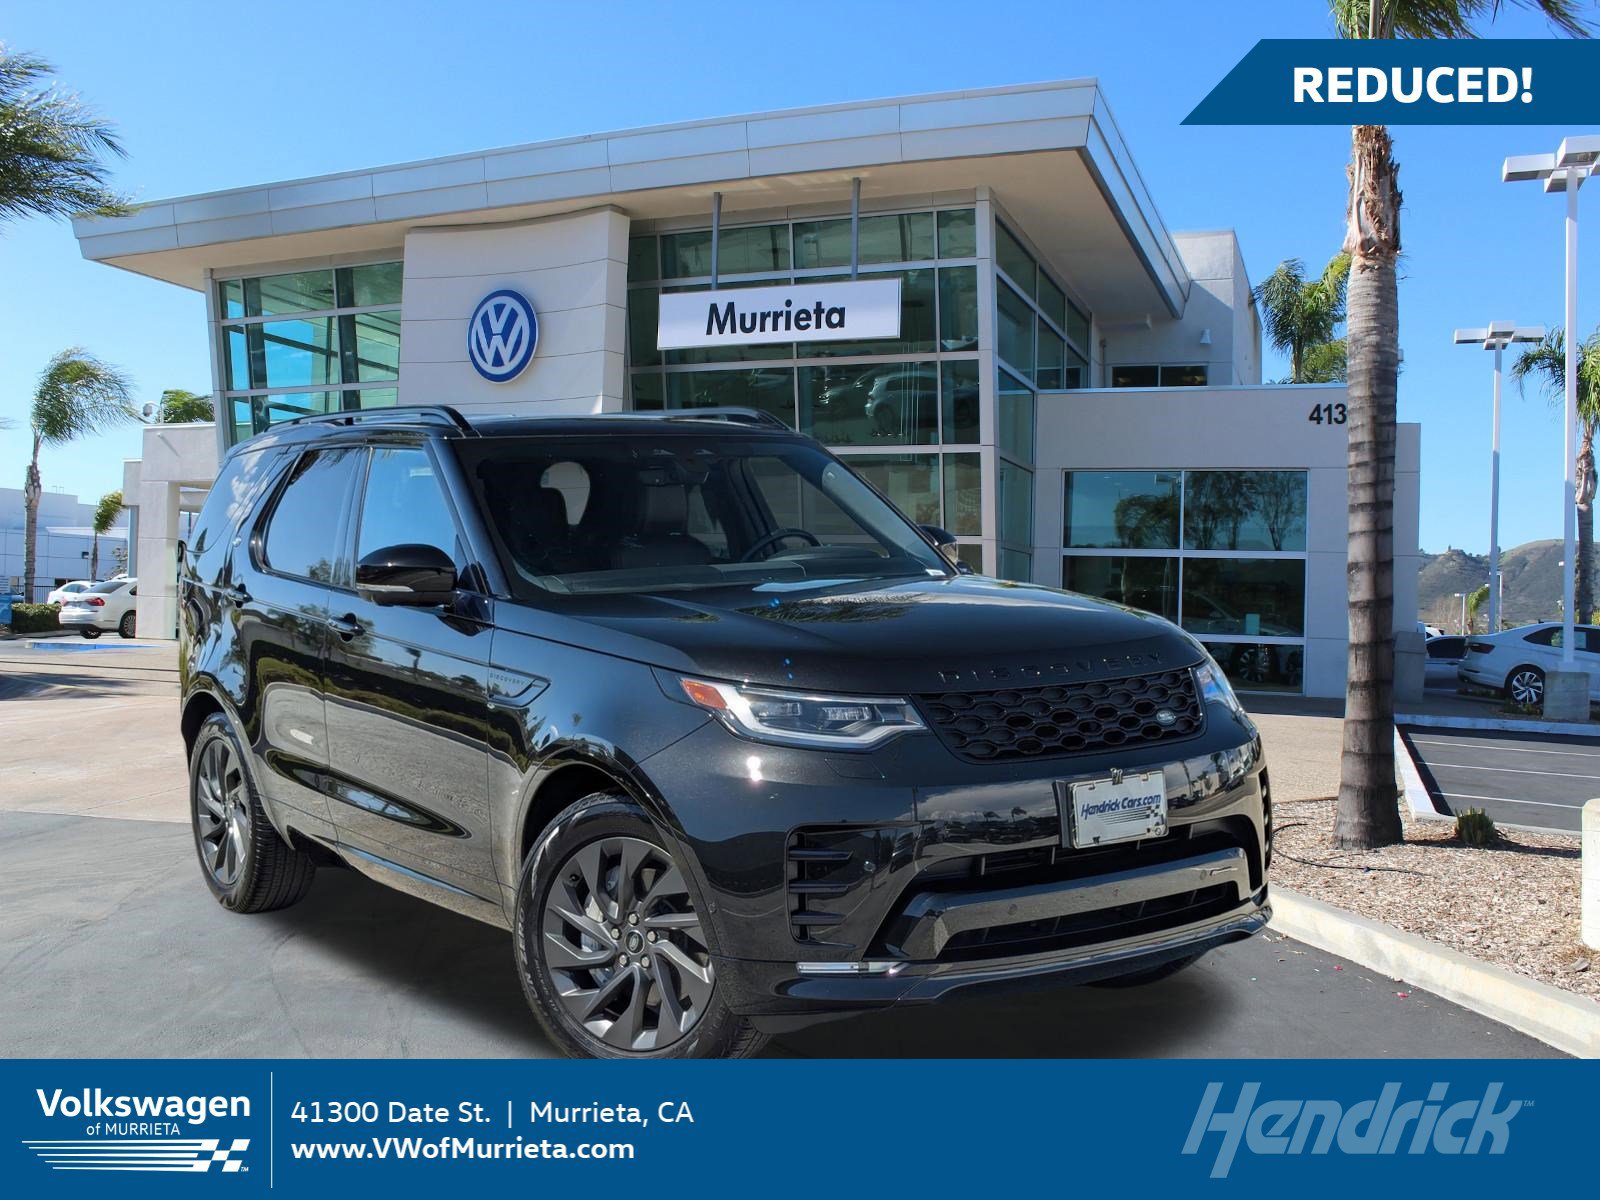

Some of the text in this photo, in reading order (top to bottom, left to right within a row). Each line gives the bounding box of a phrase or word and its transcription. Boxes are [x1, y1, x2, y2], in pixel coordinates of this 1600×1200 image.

[705, 299, 846, 336] Murrieta
[1080, 794, 1162, 820] Hendrick Cars.com
